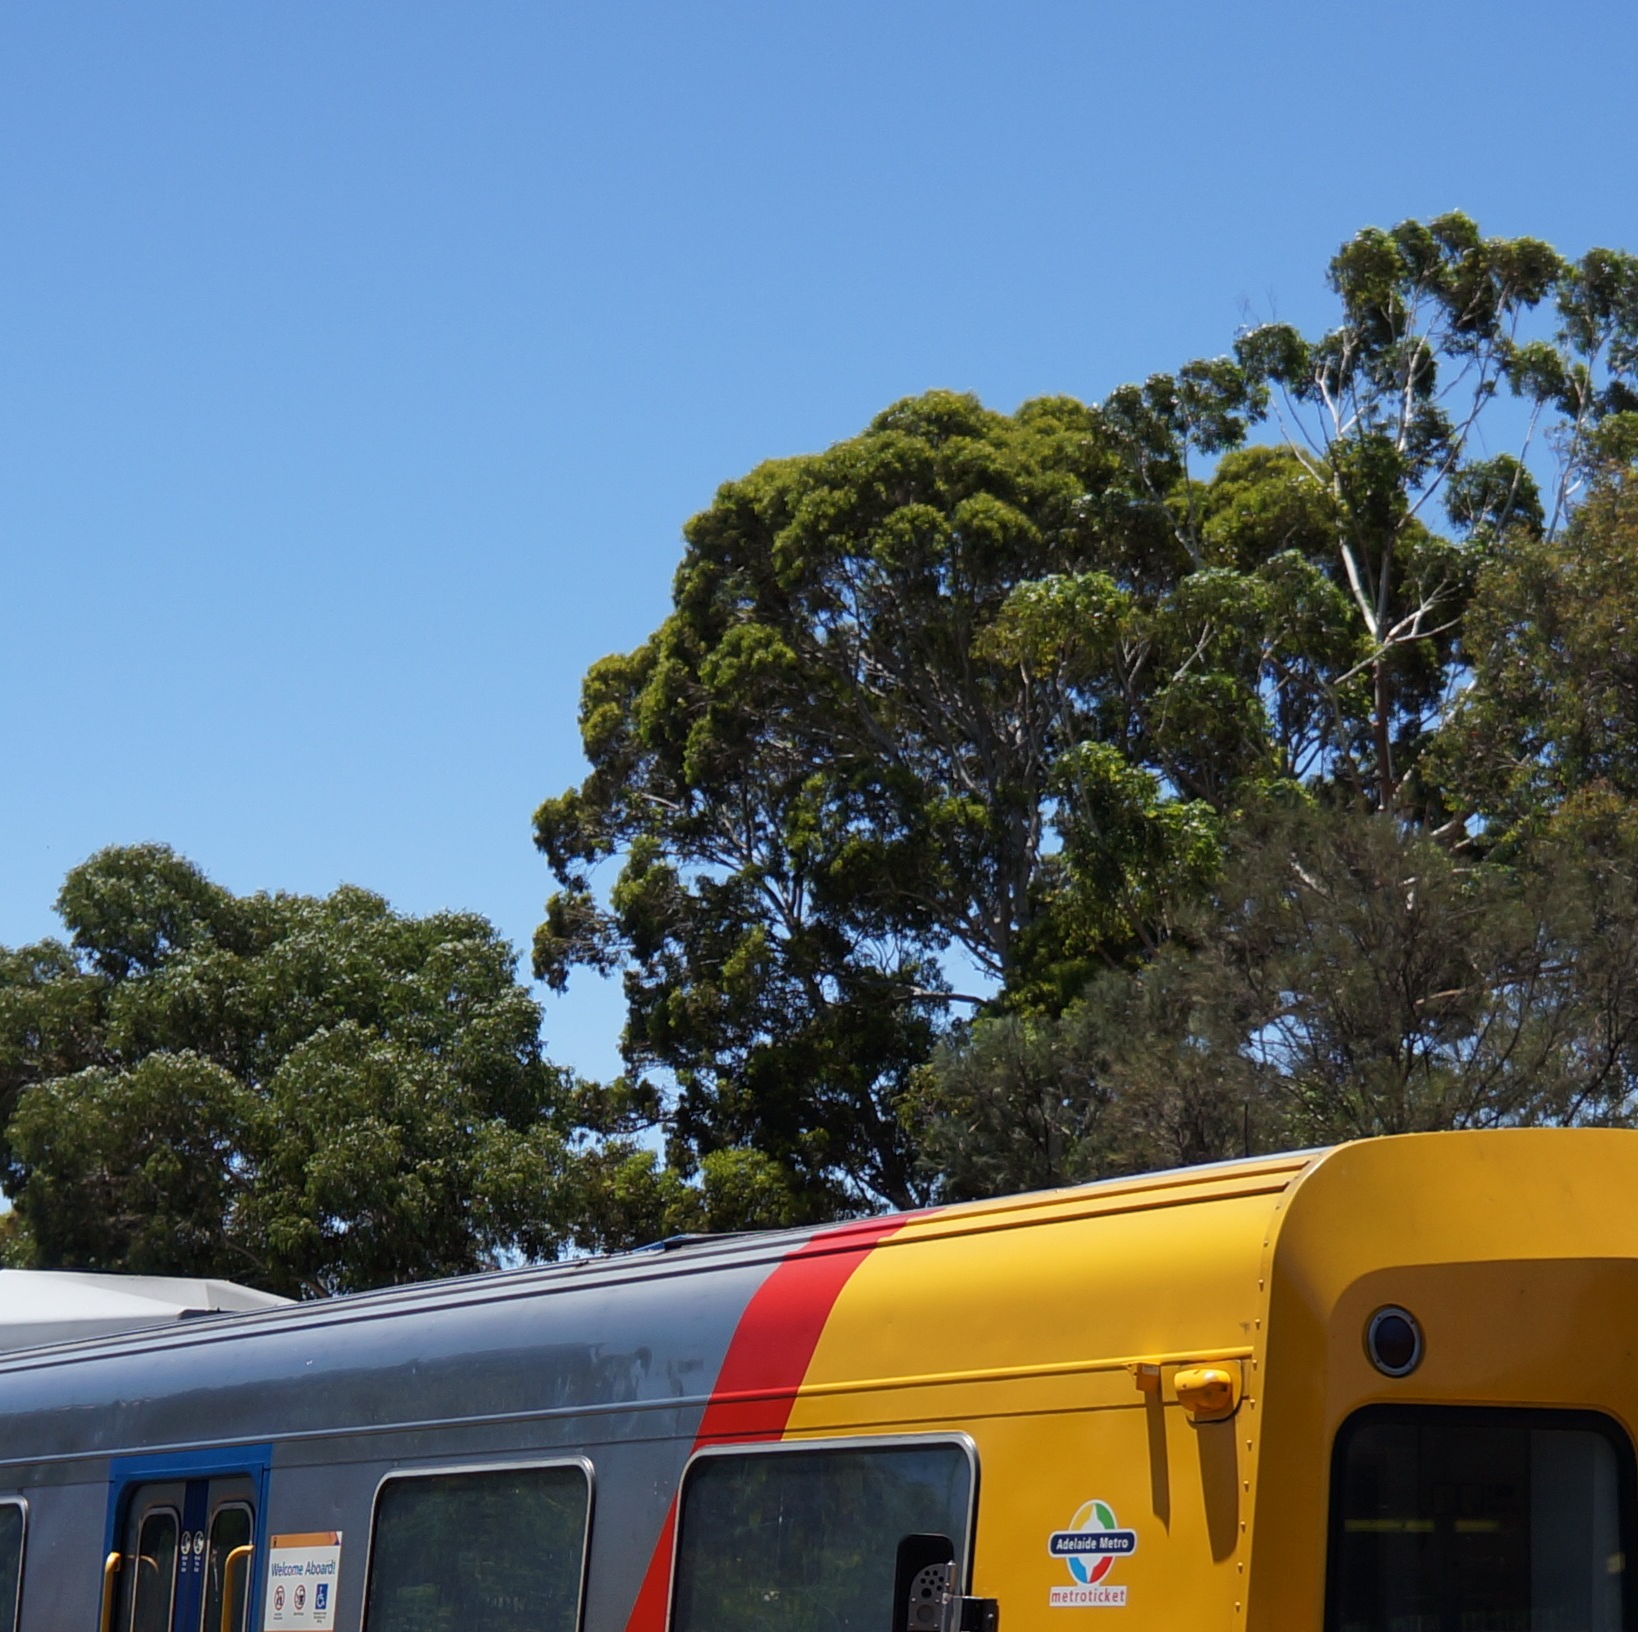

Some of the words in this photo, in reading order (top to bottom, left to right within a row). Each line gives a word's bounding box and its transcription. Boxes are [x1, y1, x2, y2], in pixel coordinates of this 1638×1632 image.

[1055, 1536, 1097, 1551] Adelaide
[1099, 1535, 1129, 1549] Metro
[271, 1562, 303, 1577] Welcome
[304, 1560, 336, 1576] Aboard!
[1051, 1588, 1126, 1604] metroticket
